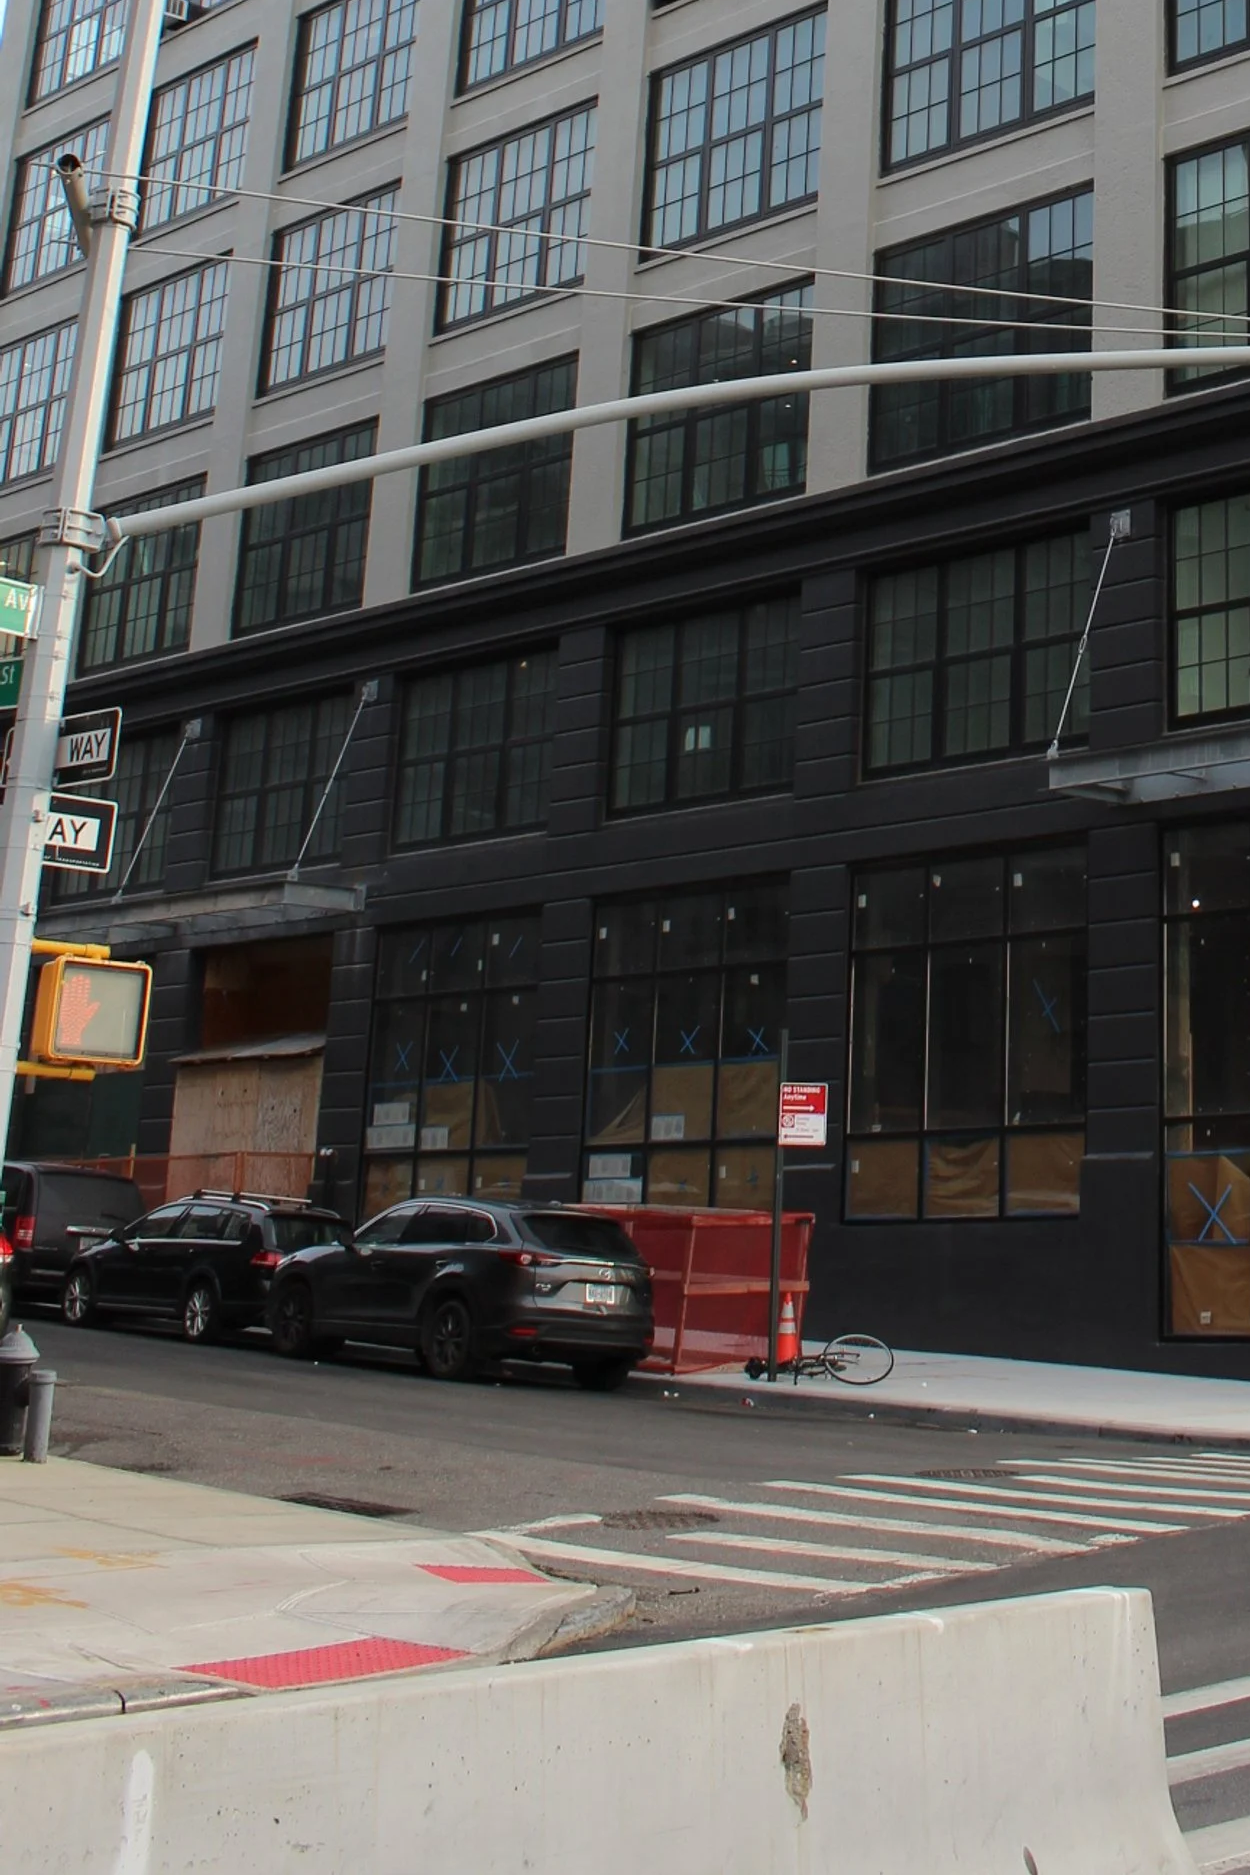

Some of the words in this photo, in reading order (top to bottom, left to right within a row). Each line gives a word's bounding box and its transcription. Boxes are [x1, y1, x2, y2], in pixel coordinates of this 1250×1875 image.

[1, 665, 15, 685] St
[69, 731, 108, 763] WAY
[46, 816, 88, 845] AY
